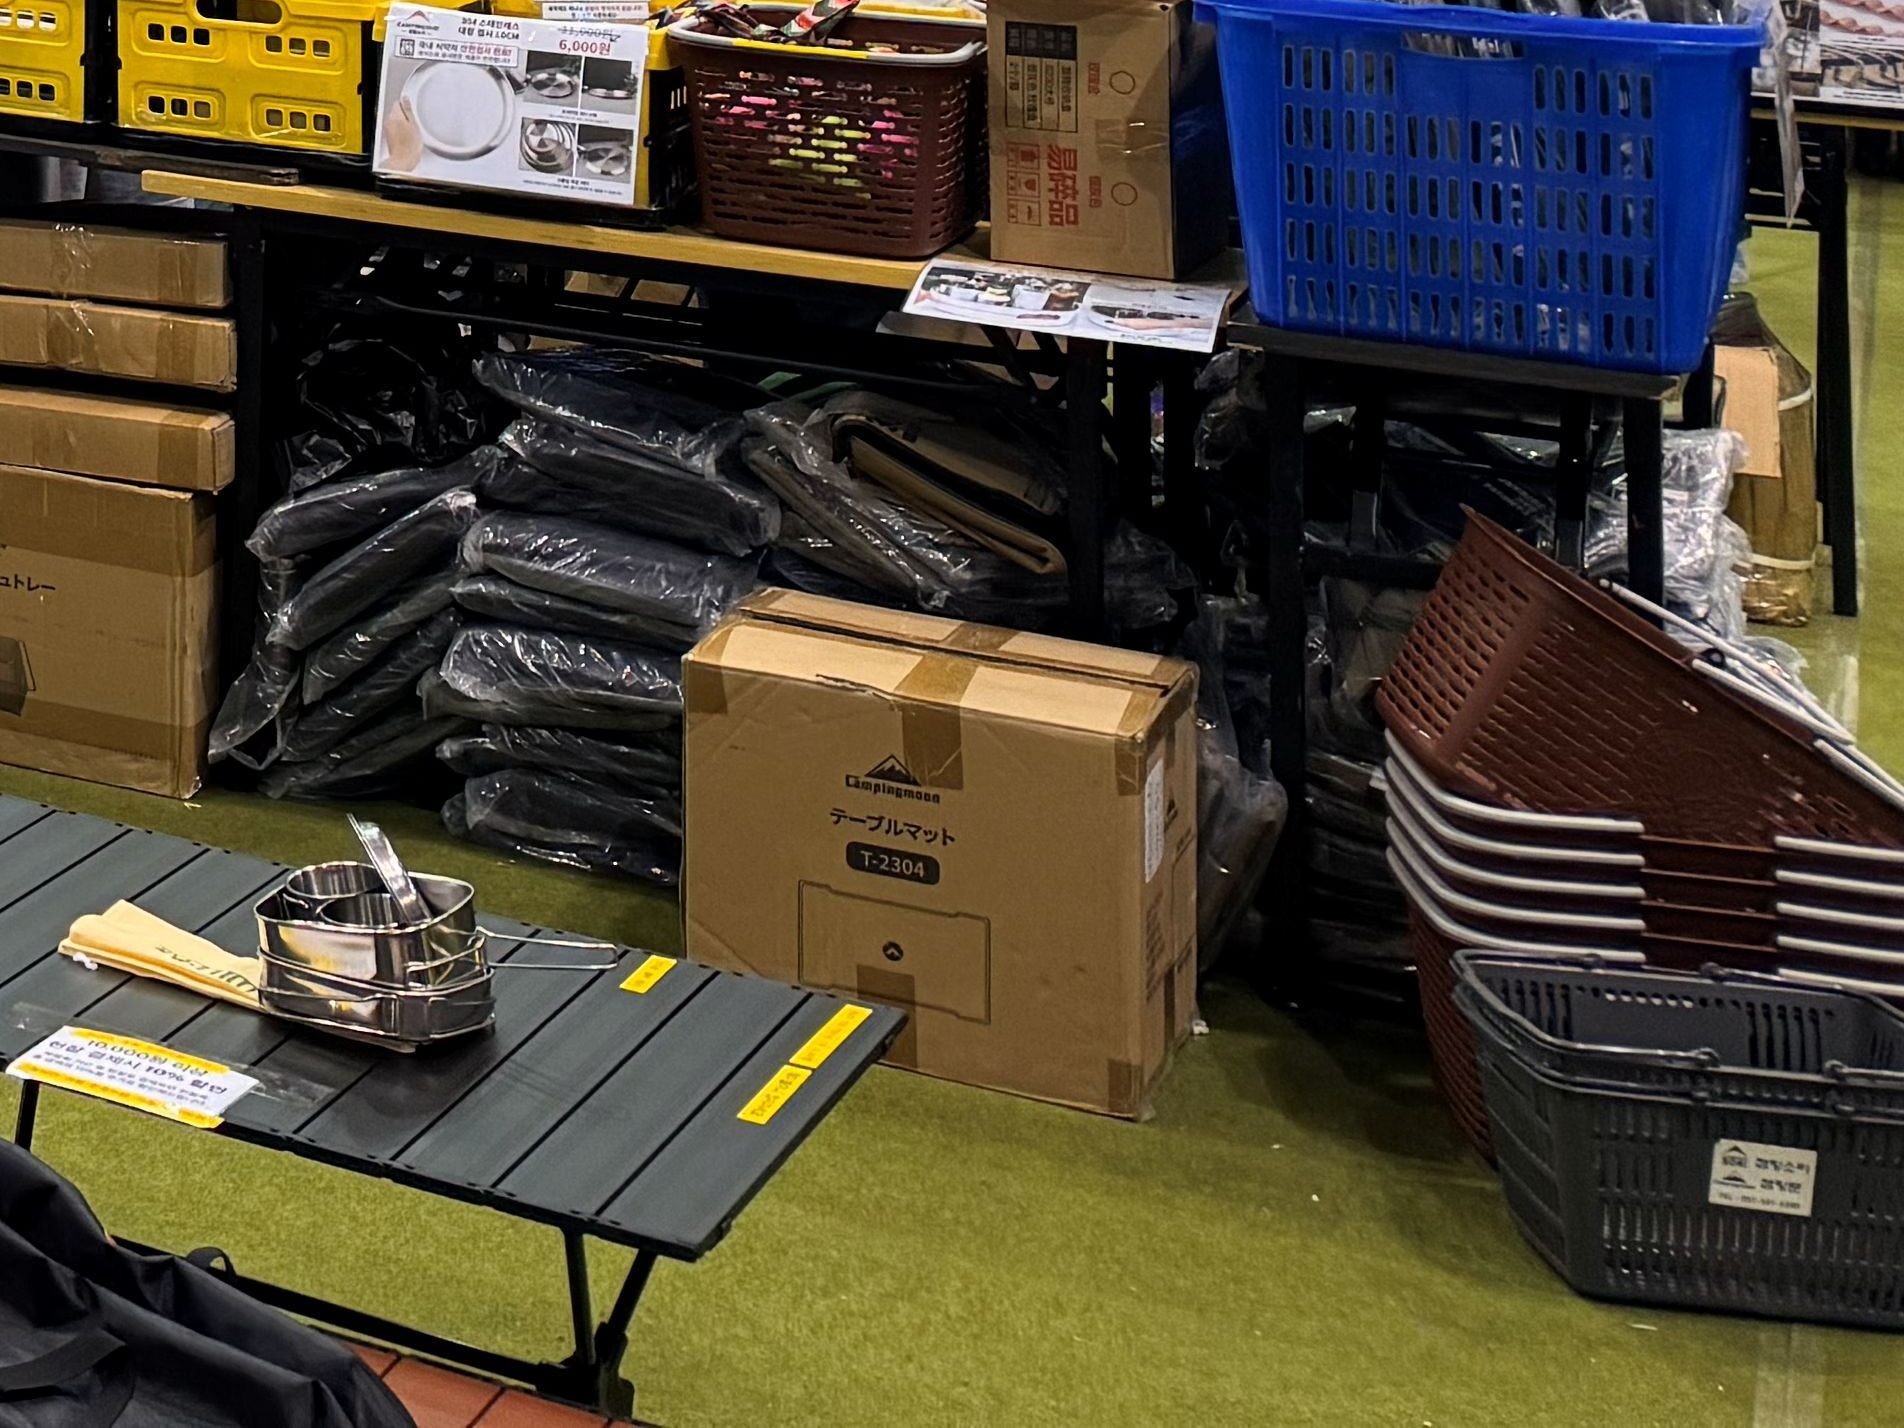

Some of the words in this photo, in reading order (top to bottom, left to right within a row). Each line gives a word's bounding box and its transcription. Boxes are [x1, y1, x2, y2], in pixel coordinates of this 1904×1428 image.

[558, 38, 611, 56] 6,000원
[1047, 144, 1079, 227] 易碎品
[845, 774, 941, 804] Campingmoon
[829, 807, 956, 846] テーブルマット
[860, 850, 925, 878] T-2304
[143, 1064, 185, 1084] 10%
